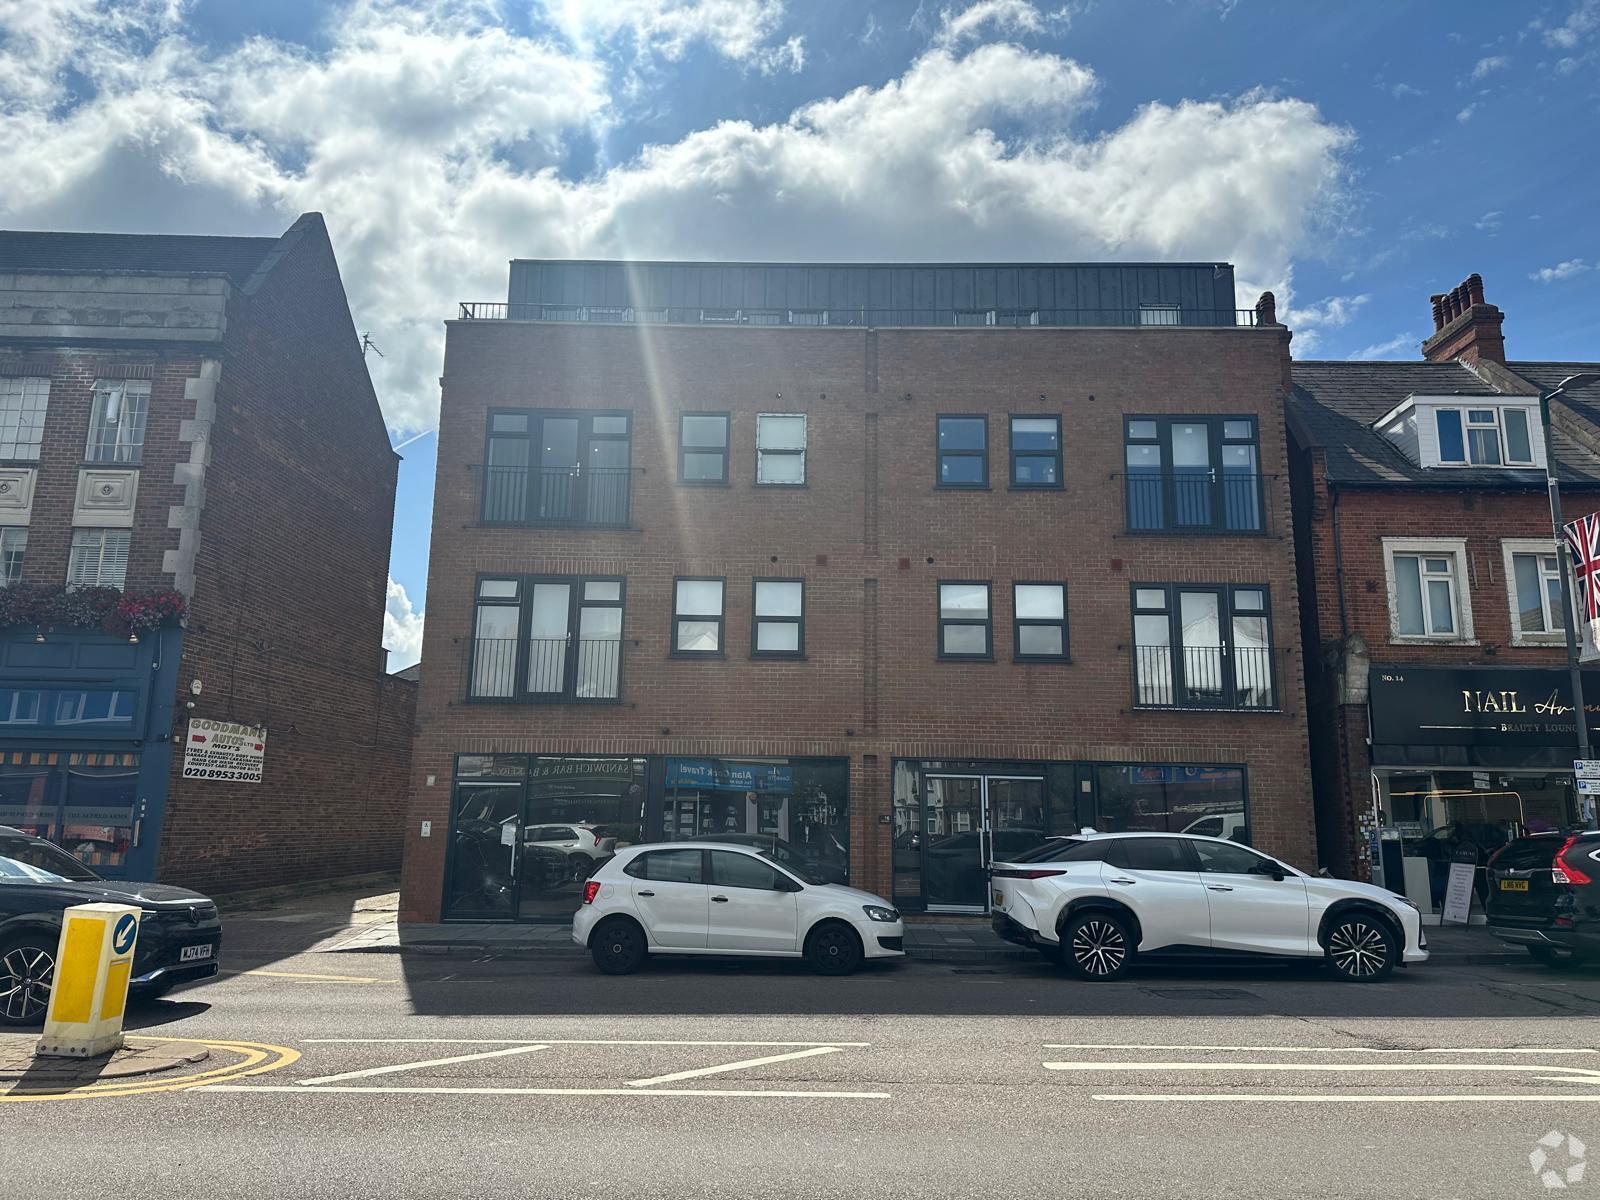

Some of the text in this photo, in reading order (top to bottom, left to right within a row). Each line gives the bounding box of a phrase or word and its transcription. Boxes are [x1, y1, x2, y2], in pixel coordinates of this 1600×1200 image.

[1395, 674, 1404, 683] 14
[1462, 690, 1527, 713] NAIL
[1501, 723, 1578, 732] BEAUTY LOUNG
[212, 744, 240, 752] MOT'S
[184, 768, 207, 777] 020
